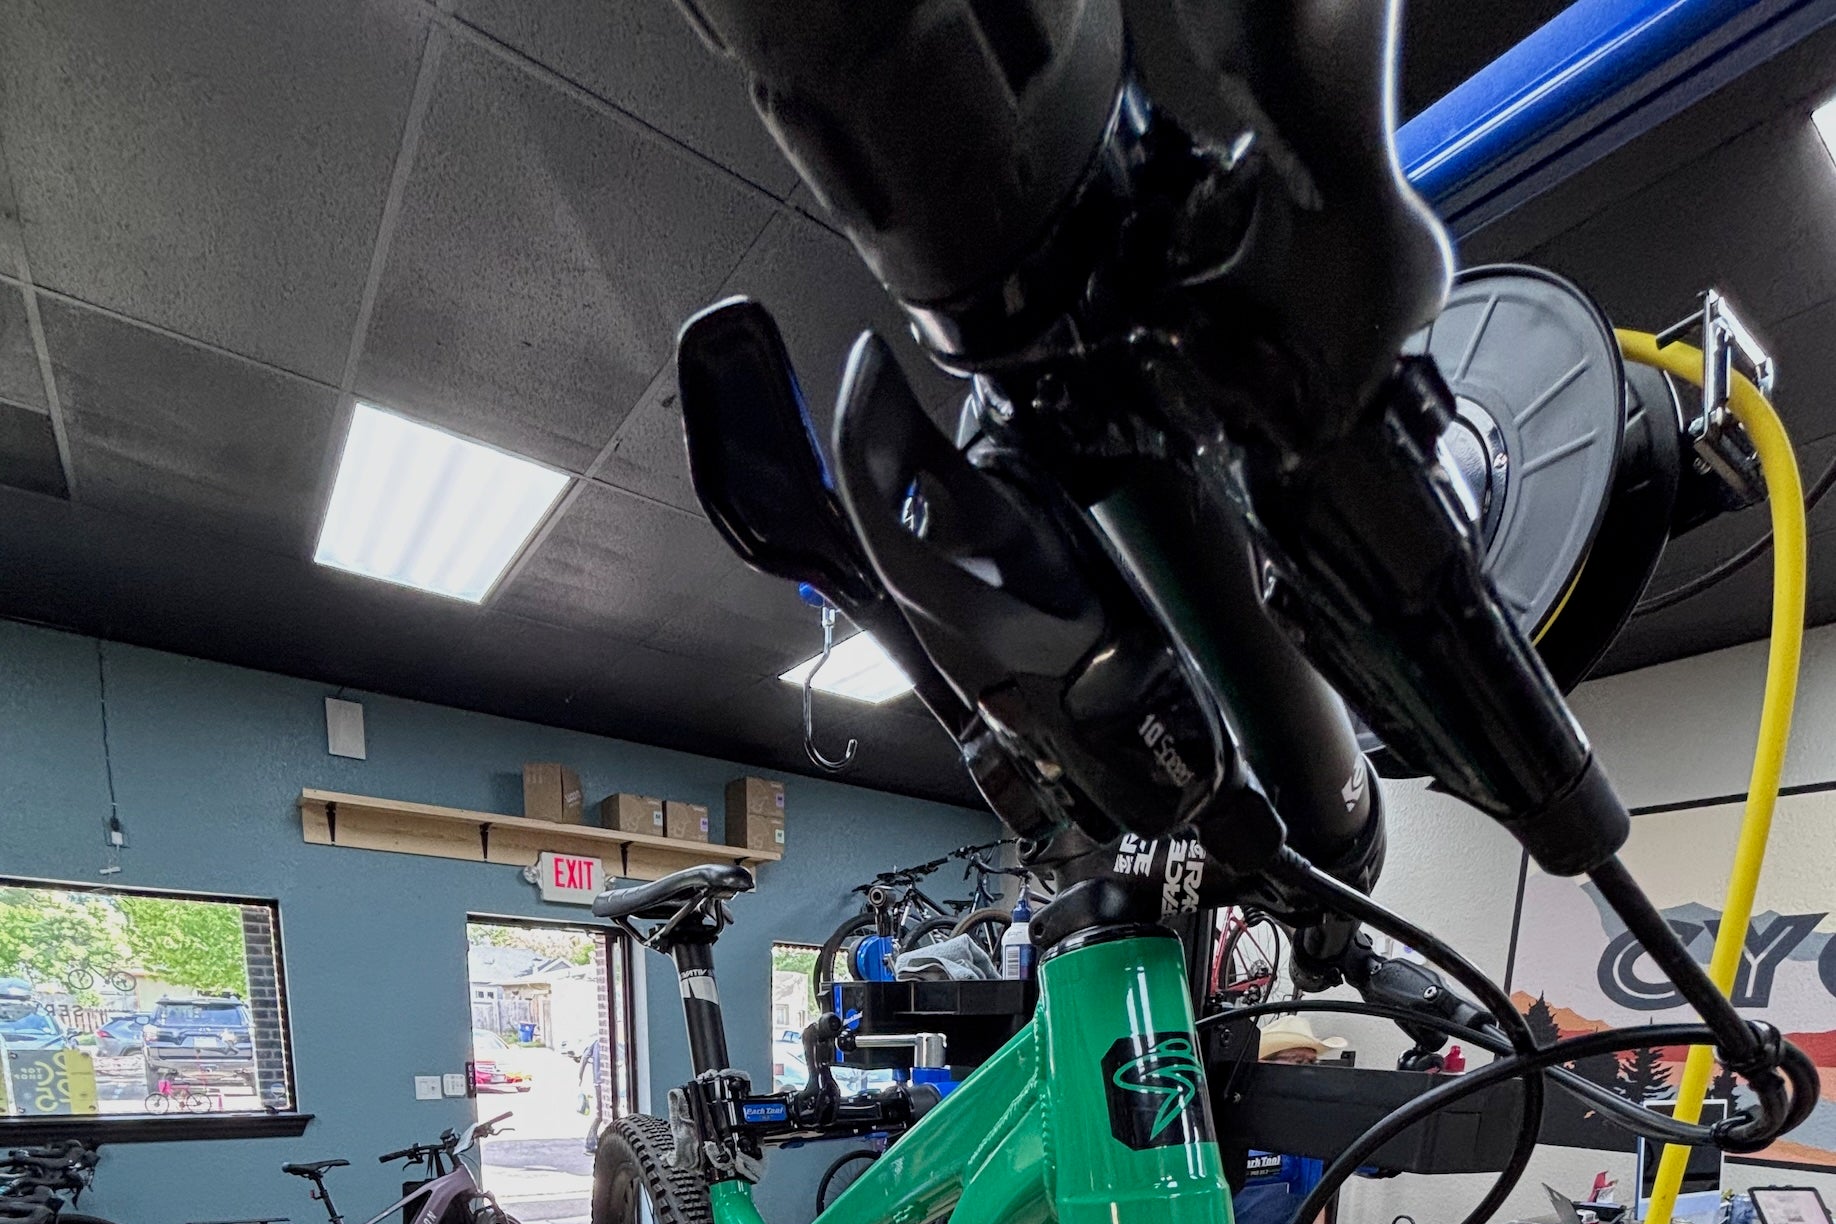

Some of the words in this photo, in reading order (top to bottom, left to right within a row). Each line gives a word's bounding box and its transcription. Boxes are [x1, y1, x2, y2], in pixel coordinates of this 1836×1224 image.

[1138, 713, 1165, 748] 10
[553, 856, 594, 891] EXIT
[1597, 911, 1836, 1012] CY
